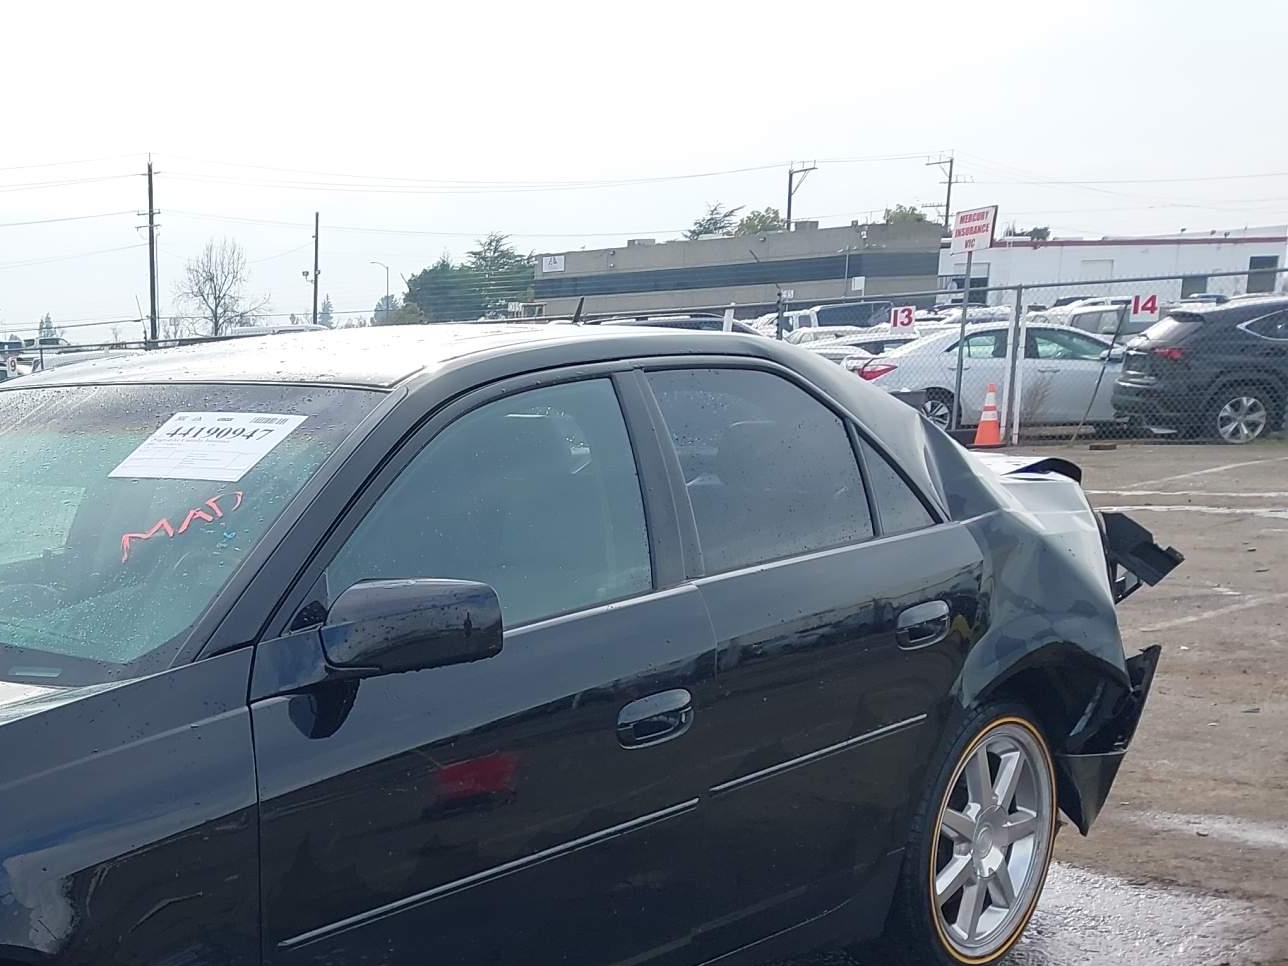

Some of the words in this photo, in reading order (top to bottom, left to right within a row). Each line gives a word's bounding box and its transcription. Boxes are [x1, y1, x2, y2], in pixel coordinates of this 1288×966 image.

[959, 211, 989, 224] MERCURY
[954, 223, 990, 238] INSURANCE
[1132, 294, 1158, 315] 14
[892, 307, 913, 328] 13
[165, 425, 275, 441] 44190947
